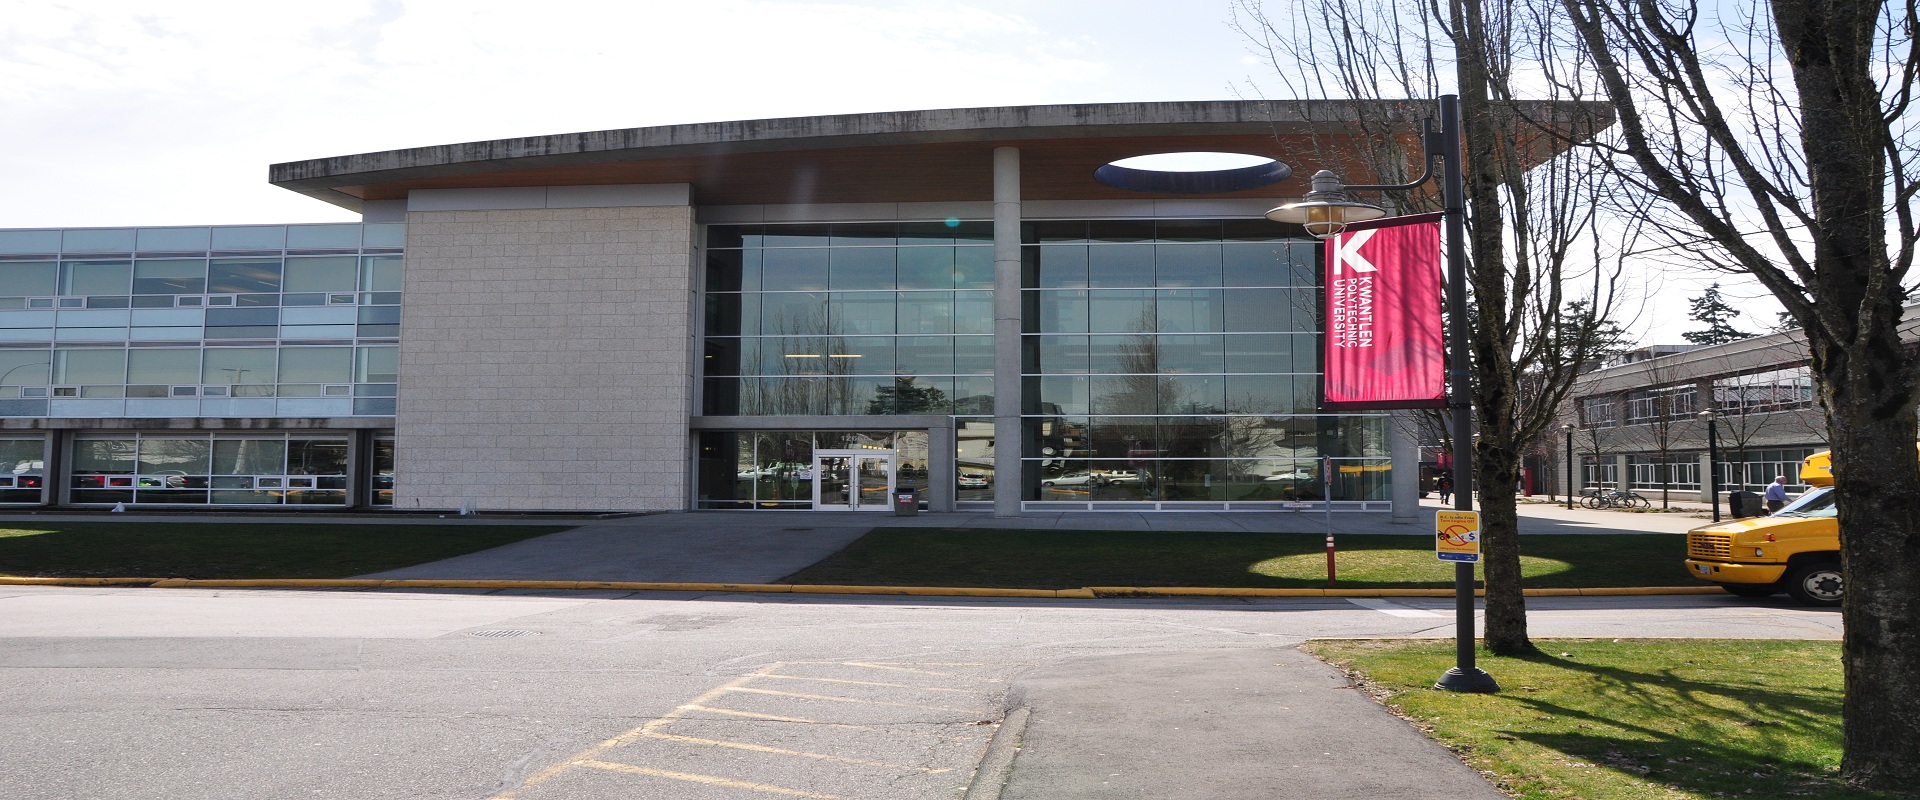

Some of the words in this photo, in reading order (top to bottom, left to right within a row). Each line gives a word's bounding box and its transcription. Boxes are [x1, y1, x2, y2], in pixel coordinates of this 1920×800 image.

[1334, 228, 1378, 275] K
[1334, 279, 1345, 348] UNIVERSITY
[1347, 278, 1357, 347] POLYTECHNIC
[1359, 276, 1372, 347] KWANTLEN
